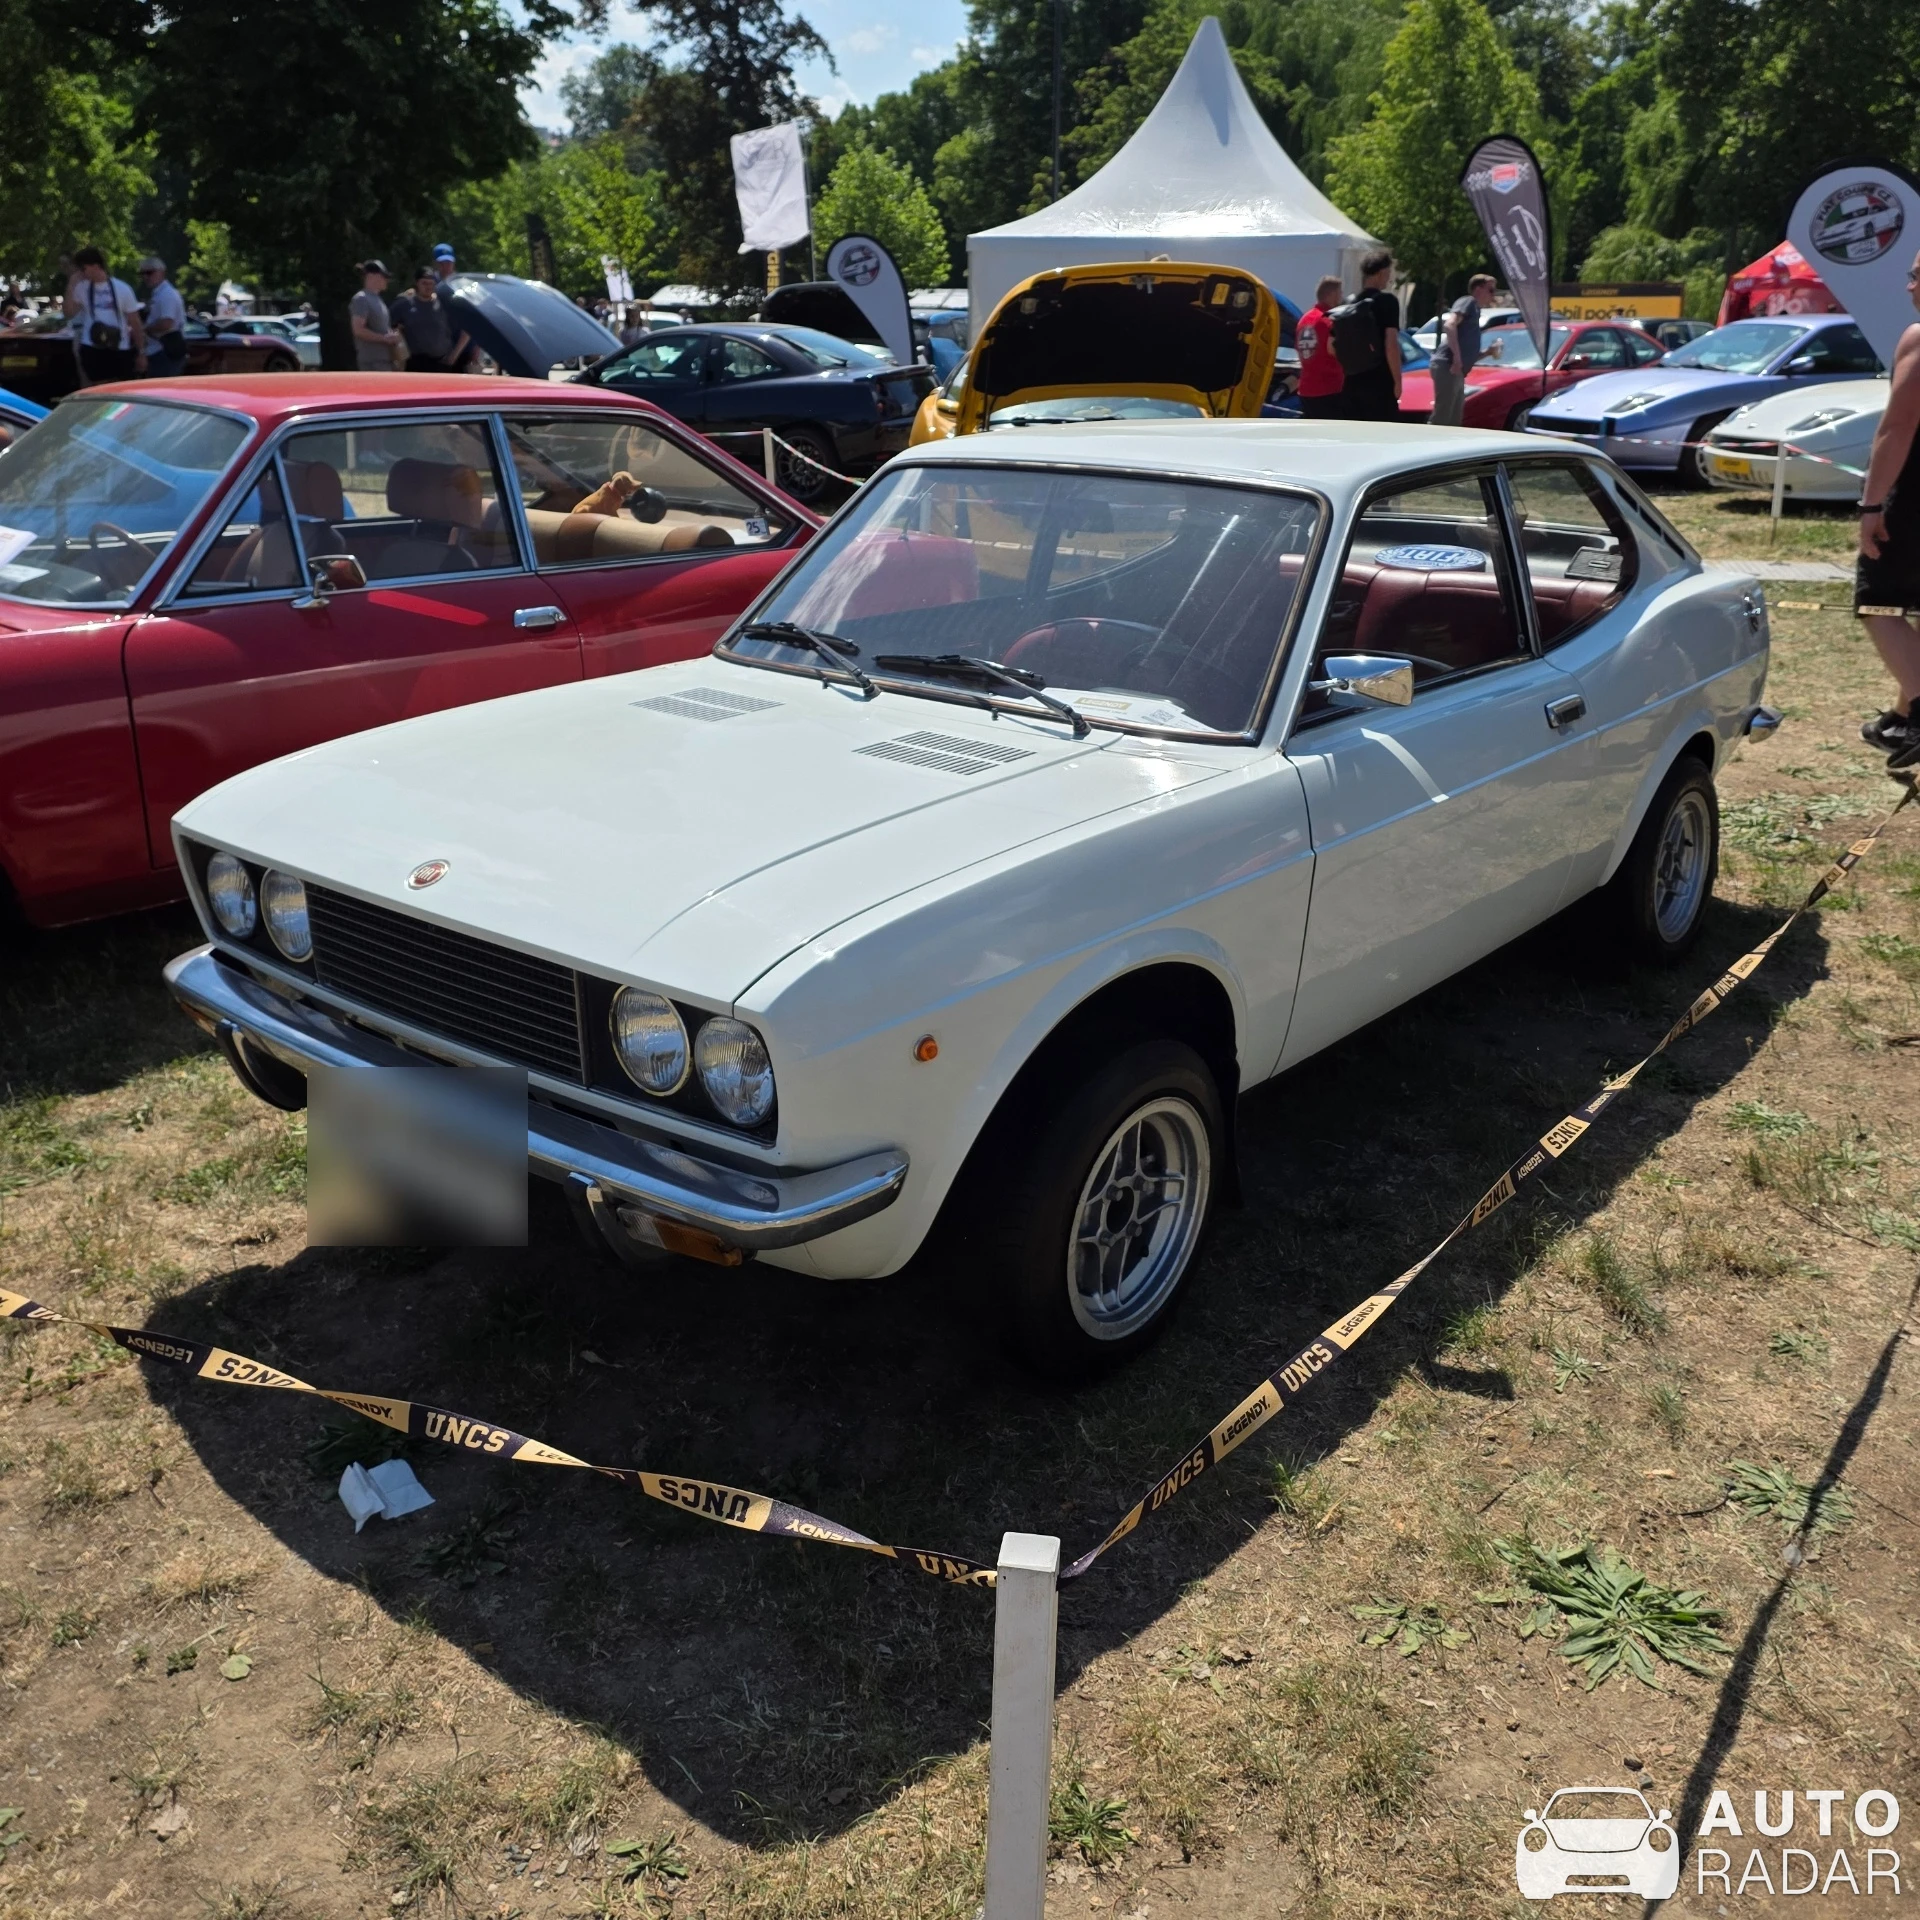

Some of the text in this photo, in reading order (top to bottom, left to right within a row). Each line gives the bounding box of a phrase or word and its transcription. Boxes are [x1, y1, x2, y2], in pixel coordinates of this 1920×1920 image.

[1397, 548, 1460, 562] FIAT
[1713, 974, 1739, 997] UNCS
[1546, 1121, 1582, 1150] UNCS
[1517, 1150, 1545, 1181] LEGENDY
[1478, 1179, 1509, 1218] UNCS
[127, 1335, 193, 1364] LEGENDY
[425, 1411, 510, 1452] UNCS
[1151, 1448, 1205, 1511] UNCS
[1279, 1343, 1333, 1392] UNCS
[658, 1479, 751, 1523] UNCS
